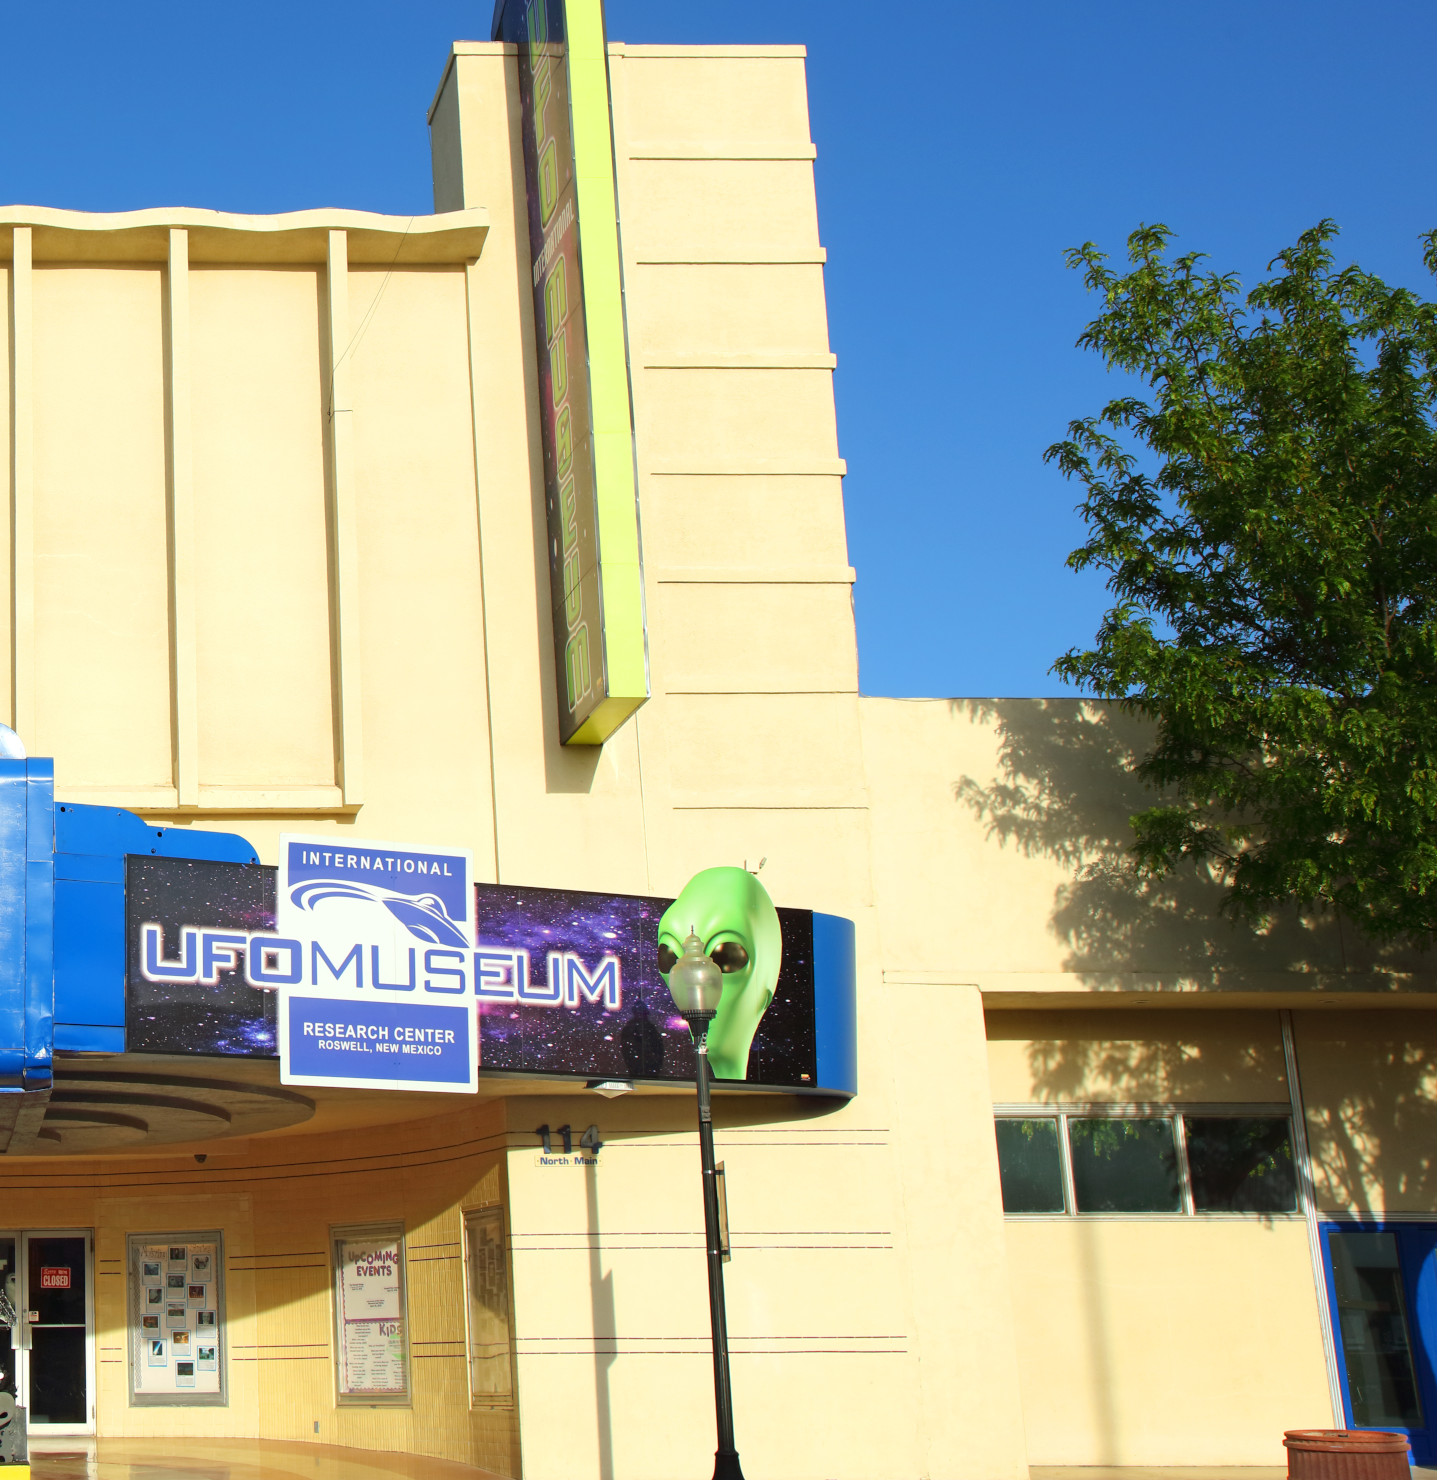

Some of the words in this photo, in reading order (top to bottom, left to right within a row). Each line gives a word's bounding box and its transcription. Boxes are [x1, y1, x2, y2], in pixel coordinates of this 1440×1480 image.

[526, 0, 559, 232] UFO
[533, 198, 575, 287] INTERNATIONAL
[544, 254, 592, 713] MUSEUM
[303, 851, 452, 876] INTERNATIONAL
[303, 1022, 389, 1040] RESEARCH
[394, 1028, 455, 1043] CENTER
[318, 1040, 372, 1053] ROSWELL,
[376, 1043, 400, 1053] NEW
[402, 1044, 442, 1055] MEXICO
[536, 1124, 602, 1154] 114
[540, 1157, 569, 1165] North
[574, 1157, 598, 1165] Main
[43, 1275, 69, 1286] CLOSED
[357, 1265, 392, 1276] EVENTS
